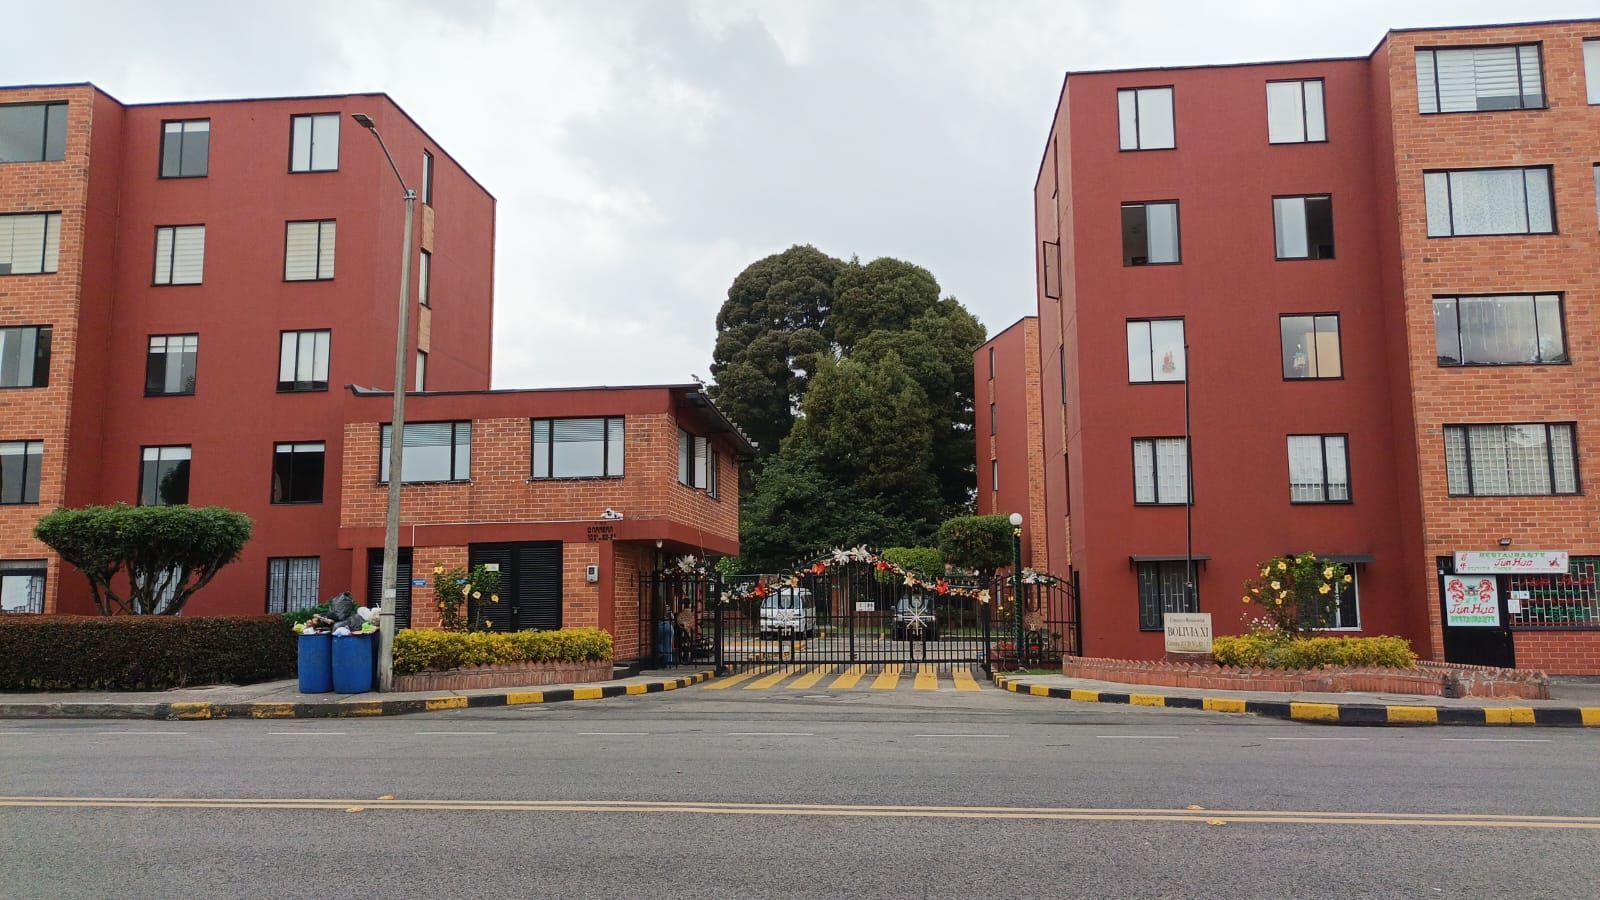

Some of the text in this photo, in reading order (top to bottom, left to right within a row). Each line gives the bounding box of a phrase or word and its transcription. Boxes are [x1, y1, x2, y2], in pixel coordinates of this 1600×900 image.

[1494, 558, 1511, 567] Jun
[1449, 604, 1469, 615] Jun
[1167, 626, 1209, 637] BOLIVIA XI
